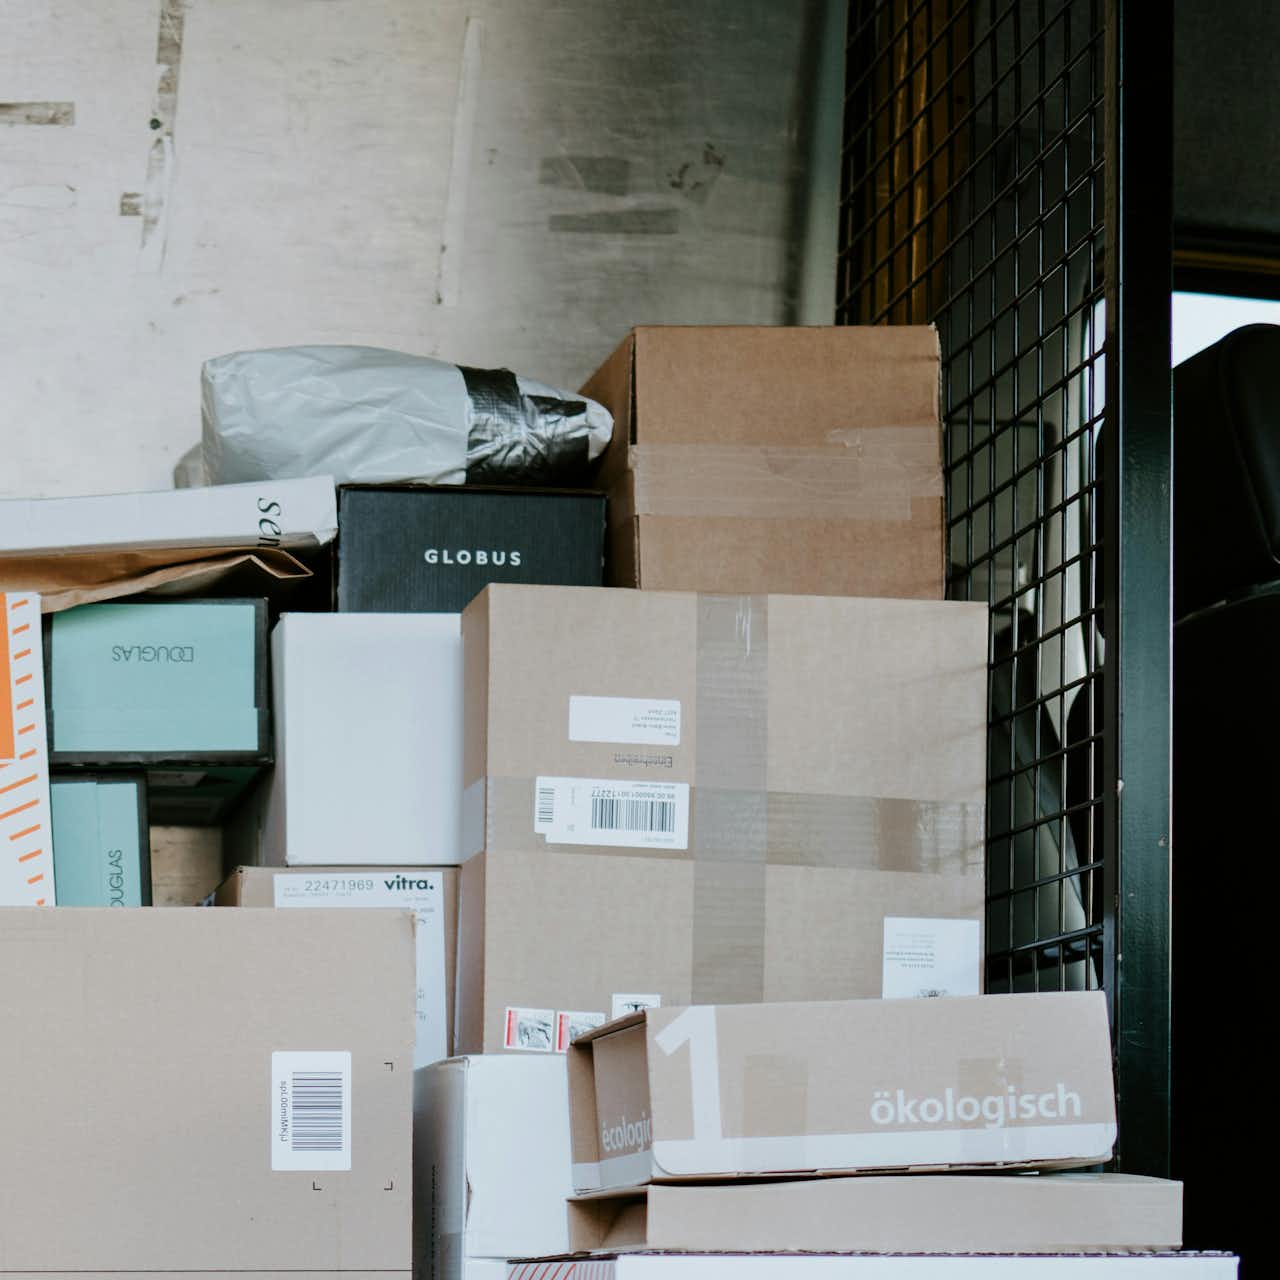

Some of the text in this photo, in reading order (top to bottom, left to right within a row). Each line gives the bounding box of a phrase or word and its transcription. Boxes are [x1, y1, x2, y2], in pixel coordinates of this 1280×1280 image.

[423, 548, 522, 567] GLOBUS
[111, 645, 194, 663] DOUGLAS
[304, 880, 374, 892] 22471969
[384, 875, 435, 891] vitra.
[869, 1083, 1082, 1130] ökologisch
